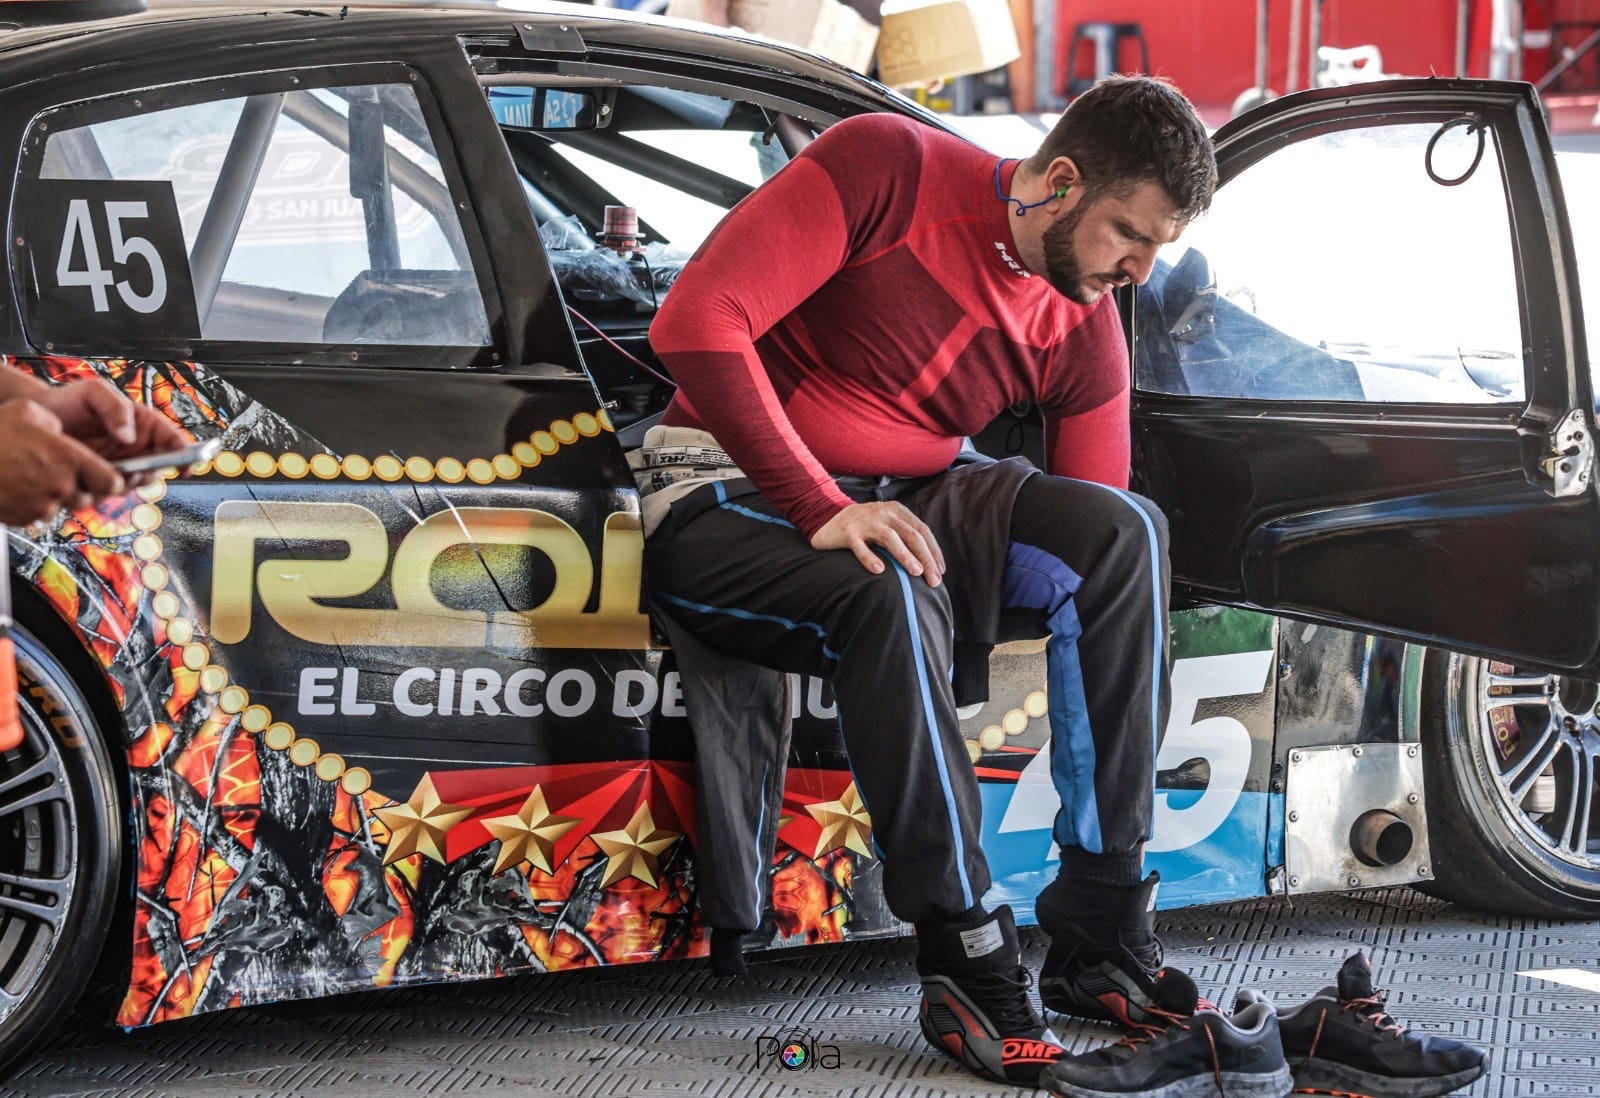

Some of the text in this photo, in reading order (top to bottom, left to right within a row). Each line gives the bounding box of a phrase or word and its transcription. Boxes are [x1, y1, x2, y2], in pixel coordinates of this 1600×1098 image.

[265, 199, 321, 220] SAN
[56, 198, 168, 314] 45
[659, 455, 686, 464] HRX
[297, 667, 376, 716] EL
[393, 667, 597, 718] CIRCO
[1001, 1042, 1064, 1059] OMP
